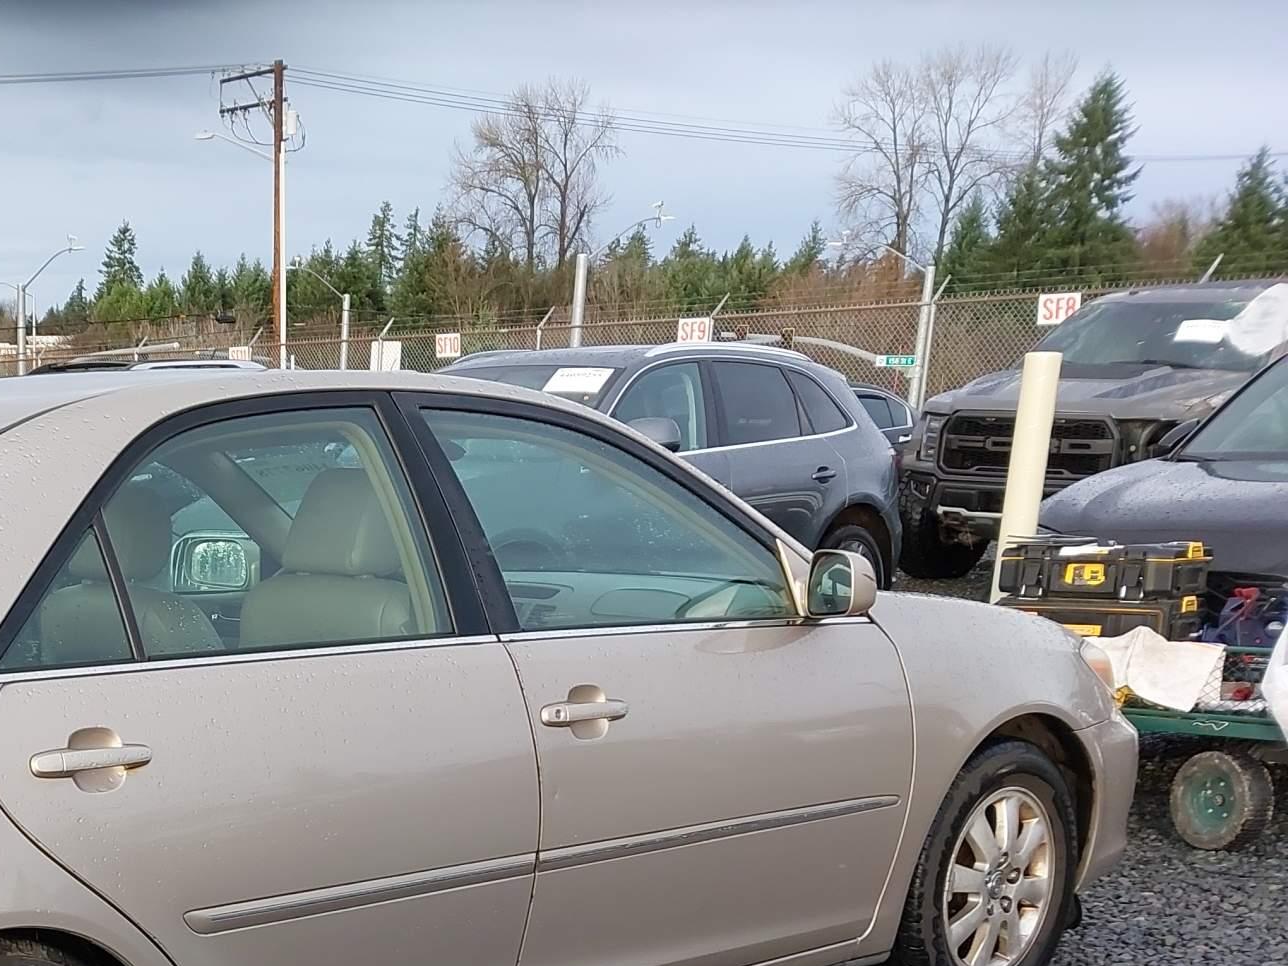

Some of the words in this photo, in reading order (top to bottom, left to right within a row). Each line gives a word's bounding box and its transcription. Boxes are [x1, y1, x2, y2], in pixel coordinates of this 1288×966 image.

[1043, 297, 1076, 320] SF8
[681, 321, 706, 340] SF9
[438, 337, 459, 353] SF10
